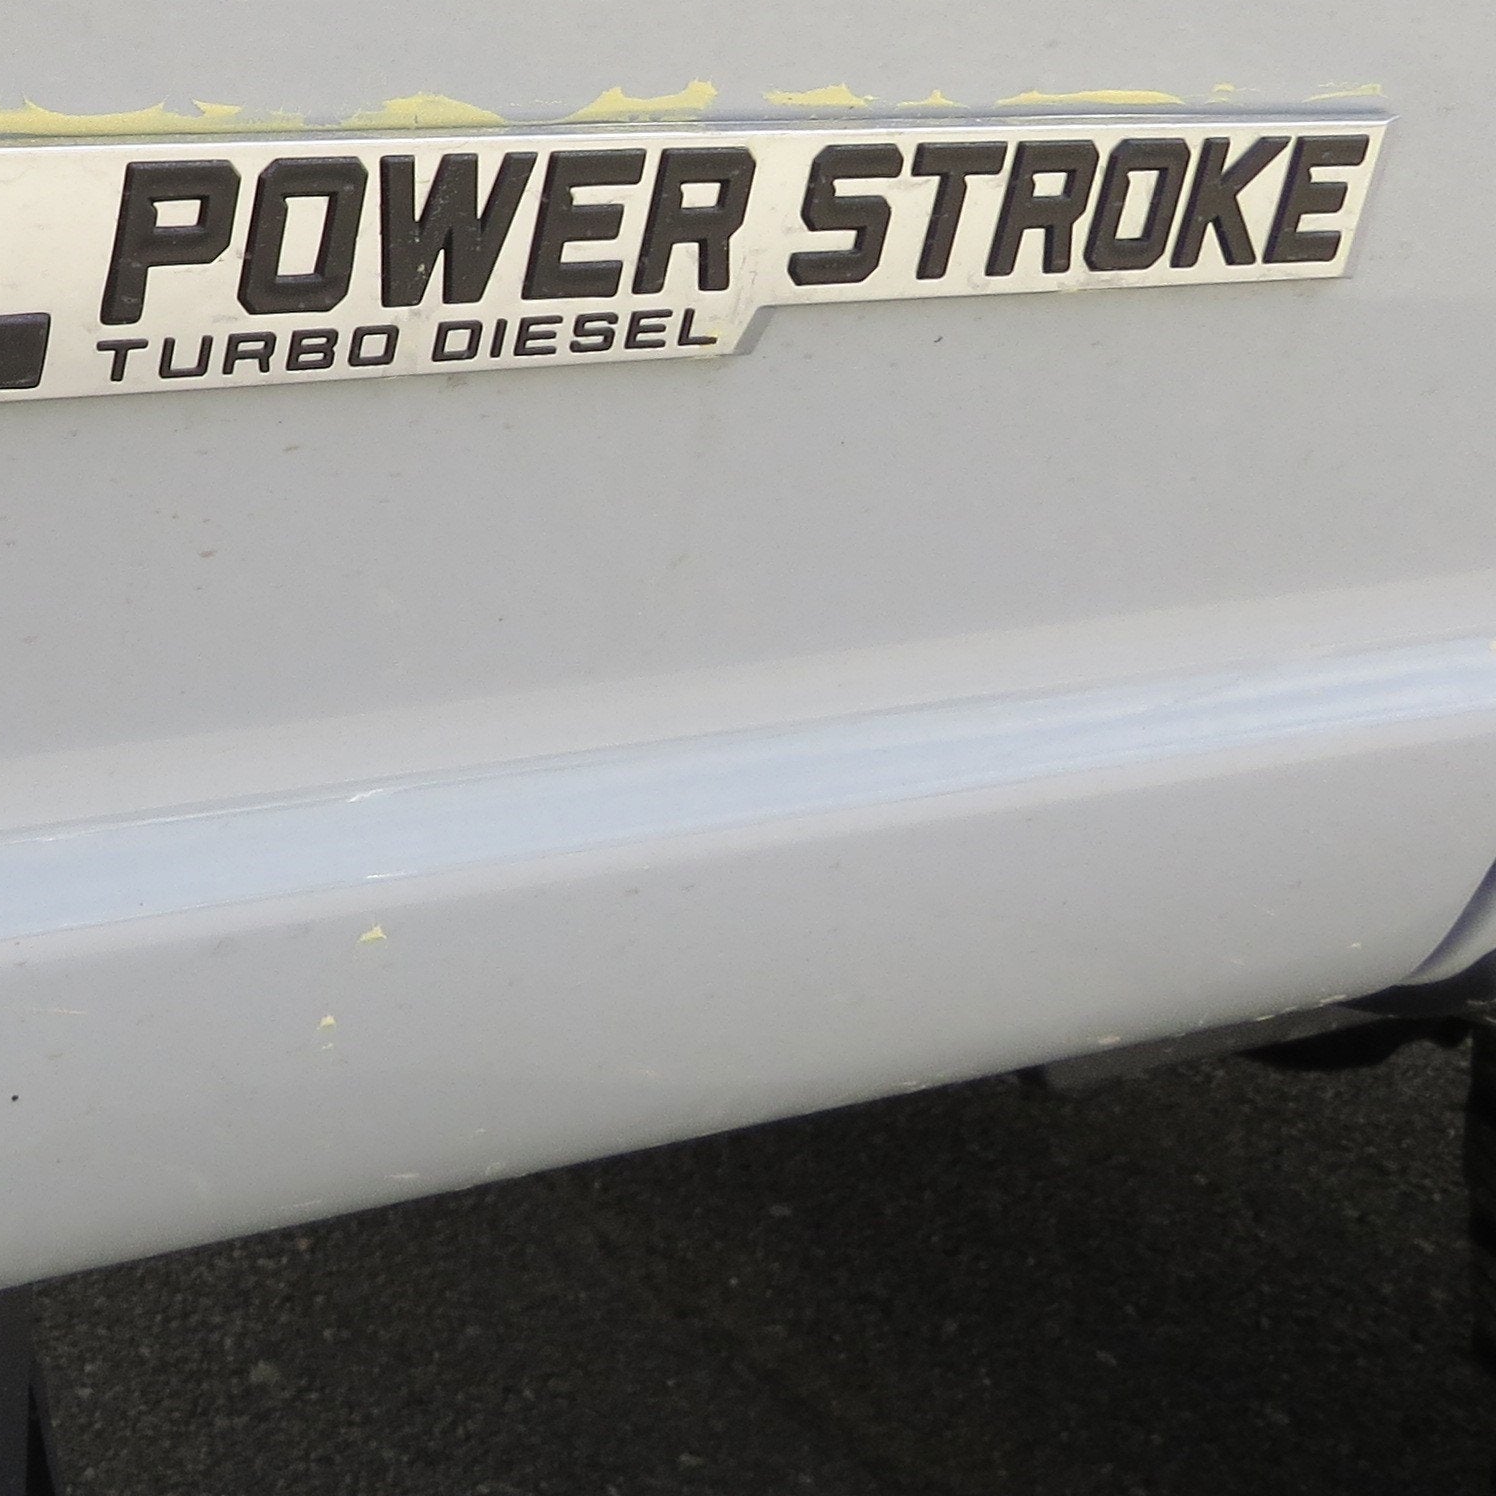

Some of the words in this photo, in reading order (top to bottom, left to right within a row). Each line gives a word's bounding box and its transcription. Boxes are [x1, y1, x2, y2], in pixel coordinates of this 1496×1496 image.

[99, 146, 757, 326] POWER
[787, 134, 1370, 288] STROKE
[96, 324, 399, 383] TURBO
[431, 308, 718, 362] DIESEL
